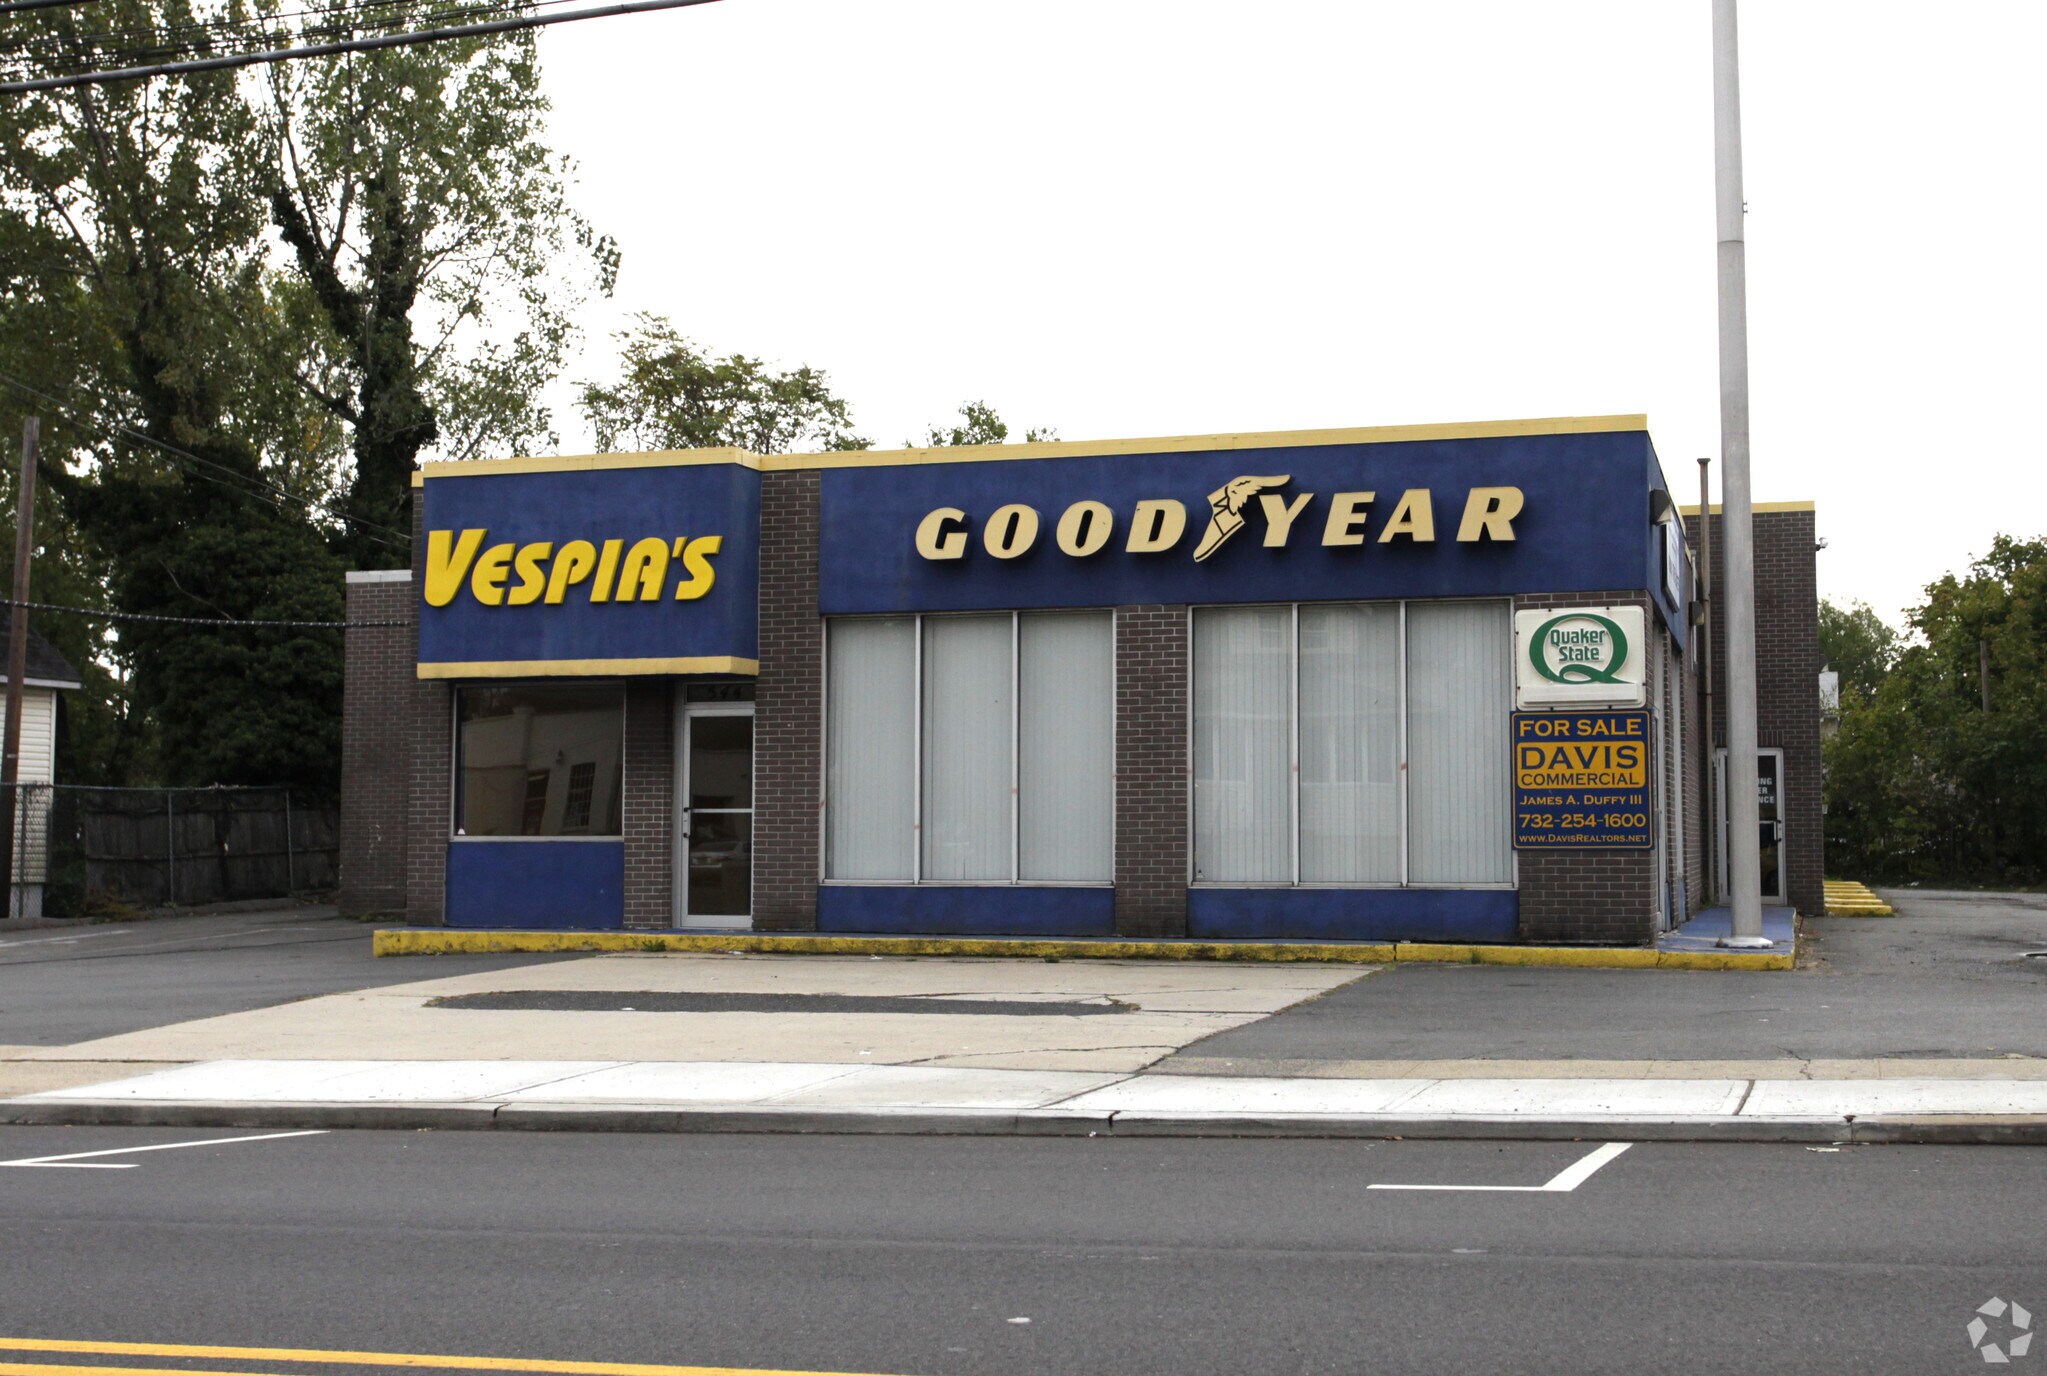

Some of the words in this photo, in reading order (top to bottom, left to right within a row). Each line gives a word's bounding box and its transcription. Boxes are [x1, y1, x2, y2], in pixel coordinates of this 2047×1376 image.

[1550, 628, 1605, 646] Quaker
[1558, 645, 1600, 661] State
[1519, 719, 1570, 737] FOR
[1576, 718, 1642, 736] SALE
[1520, 745, 1639, 770] DAVIS
[1521, 772, 1639, 786] COMMERCIAL
[1520, 795, 1563, 805] JAMES
[1566, 795, 1580, 805] A.
[1583, 794, 1627, 805] DUFFY
[1519, 813, 1647, 828] 732-254-1600
